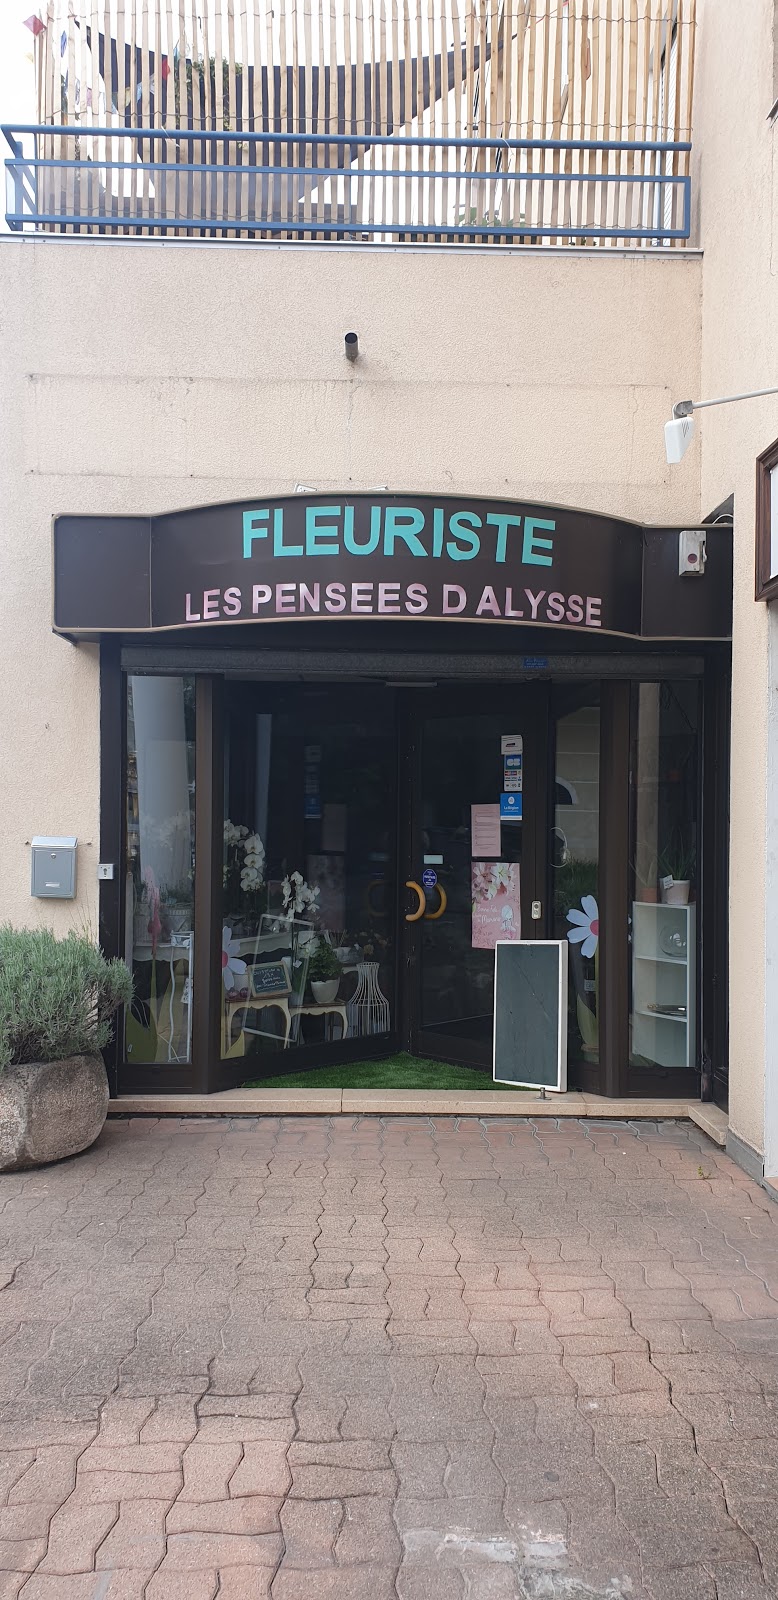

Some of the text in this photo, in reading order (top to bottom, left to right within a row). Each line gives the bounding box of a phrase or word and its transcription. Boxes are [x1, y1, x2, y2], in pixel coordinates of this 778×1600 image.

[242, 506, 556, 567] FLEURISTE
[184, 582, 602, 627] LES PENSEES D ALYSSE
